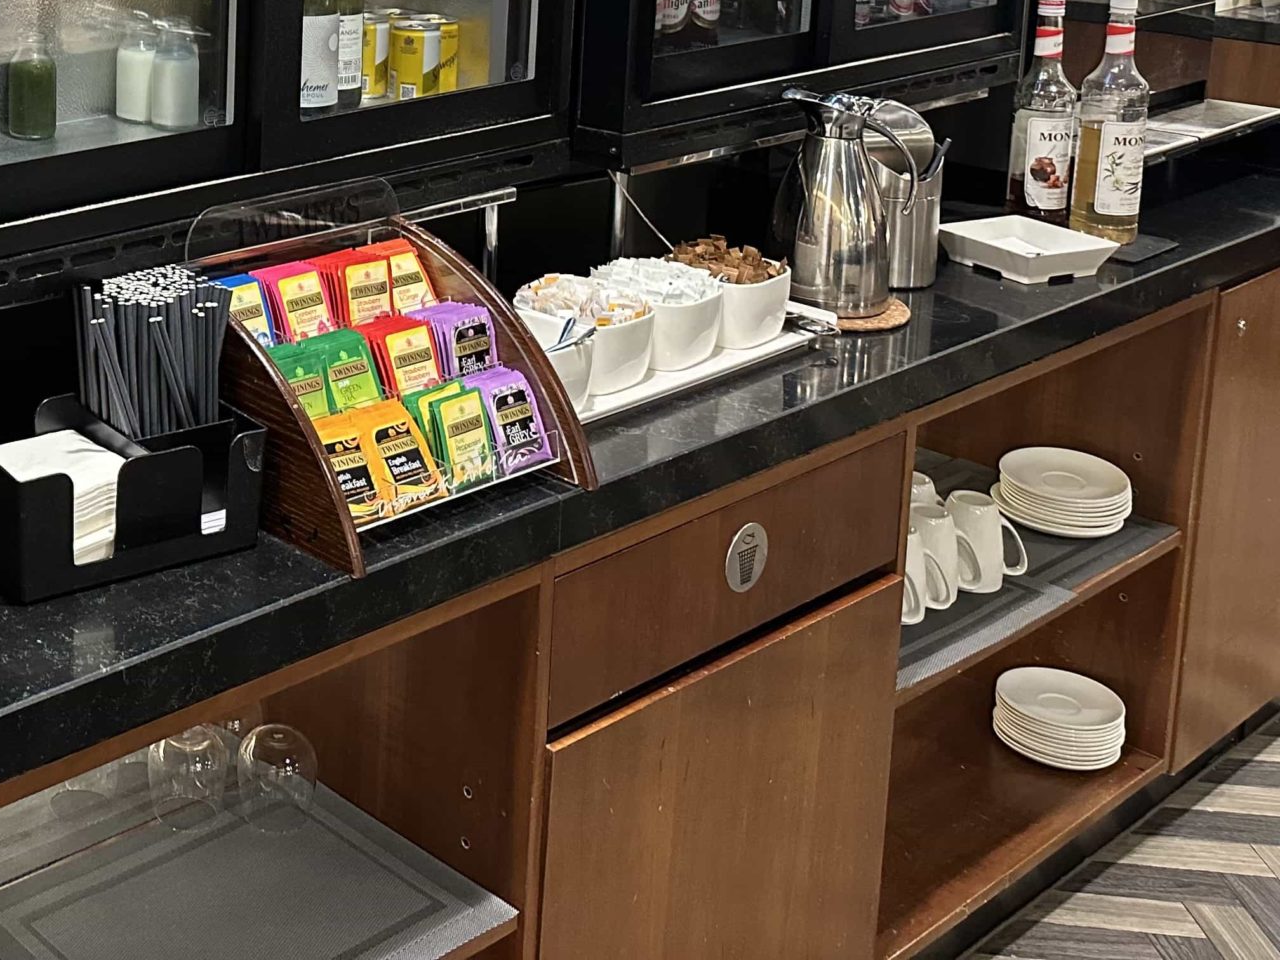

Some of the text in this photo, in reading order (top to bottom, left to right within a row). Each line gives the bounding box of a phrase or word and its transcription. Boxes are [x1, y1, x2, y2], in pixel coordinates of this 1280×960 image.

[1039, 131, 1070, 143] MON
[1113, 136, 1145, 147] MON
[353, 283, 386, 297] TWININGS
[289, 294, 322, 309] TWININGS
[457, 339, 489, 354] TWININGS
[398, 350, 431, 366] TWININGS
[332, 363, 366, 378] TWININGS
[499, 407, 531, 422] TWININGS
[450, 417, 481, 434] TWININGS
[509, 428, 530, 445] GREY
[381, 439, 418, 455] TWININGS
[388, 455, 408, 467] English
[390, 459, 423, 476] Breakfast
[337, 472, 353, 485] glish
[341, 477, 368, 491] eakfast
